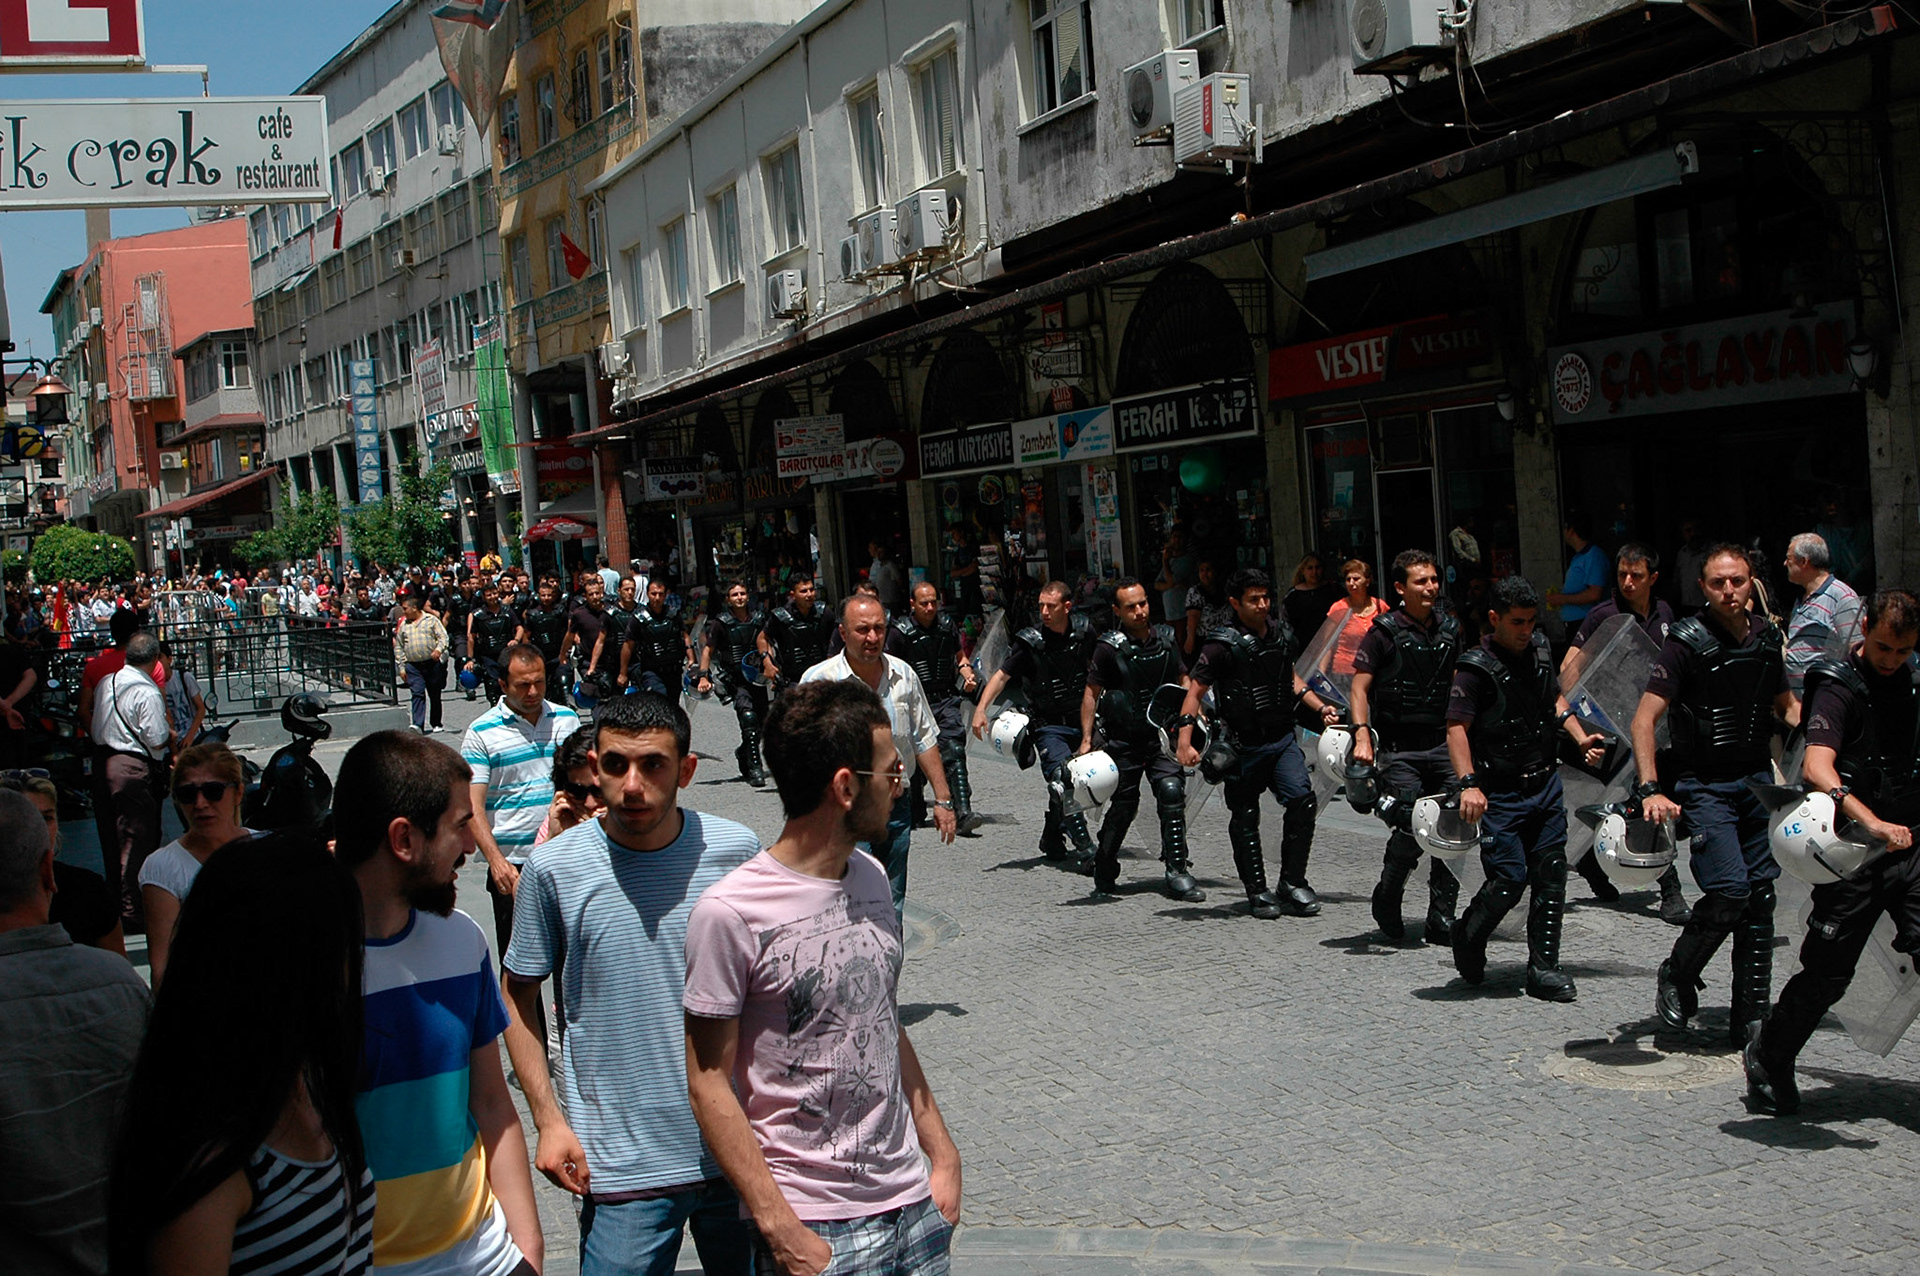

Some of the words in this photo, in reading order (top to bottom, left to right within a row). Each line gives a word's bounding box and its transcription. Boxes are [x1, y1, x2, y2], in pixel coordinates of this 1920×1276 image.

[257, 106, 292, 139] cafe
[66, 110, 222, 190] crak
[270, 143, 283, 160] &
[235, 157, 320, 190] restaurant
[1600, 320, 1846, 413] ÇAĞLAYAN
[1119, 401, 1179, 443] FERAH
[779, 453, 844, 474] BARUTÇULAR
[923, 439, 956, 473] FERAH
[1784, 822, 1803, 837] 31
